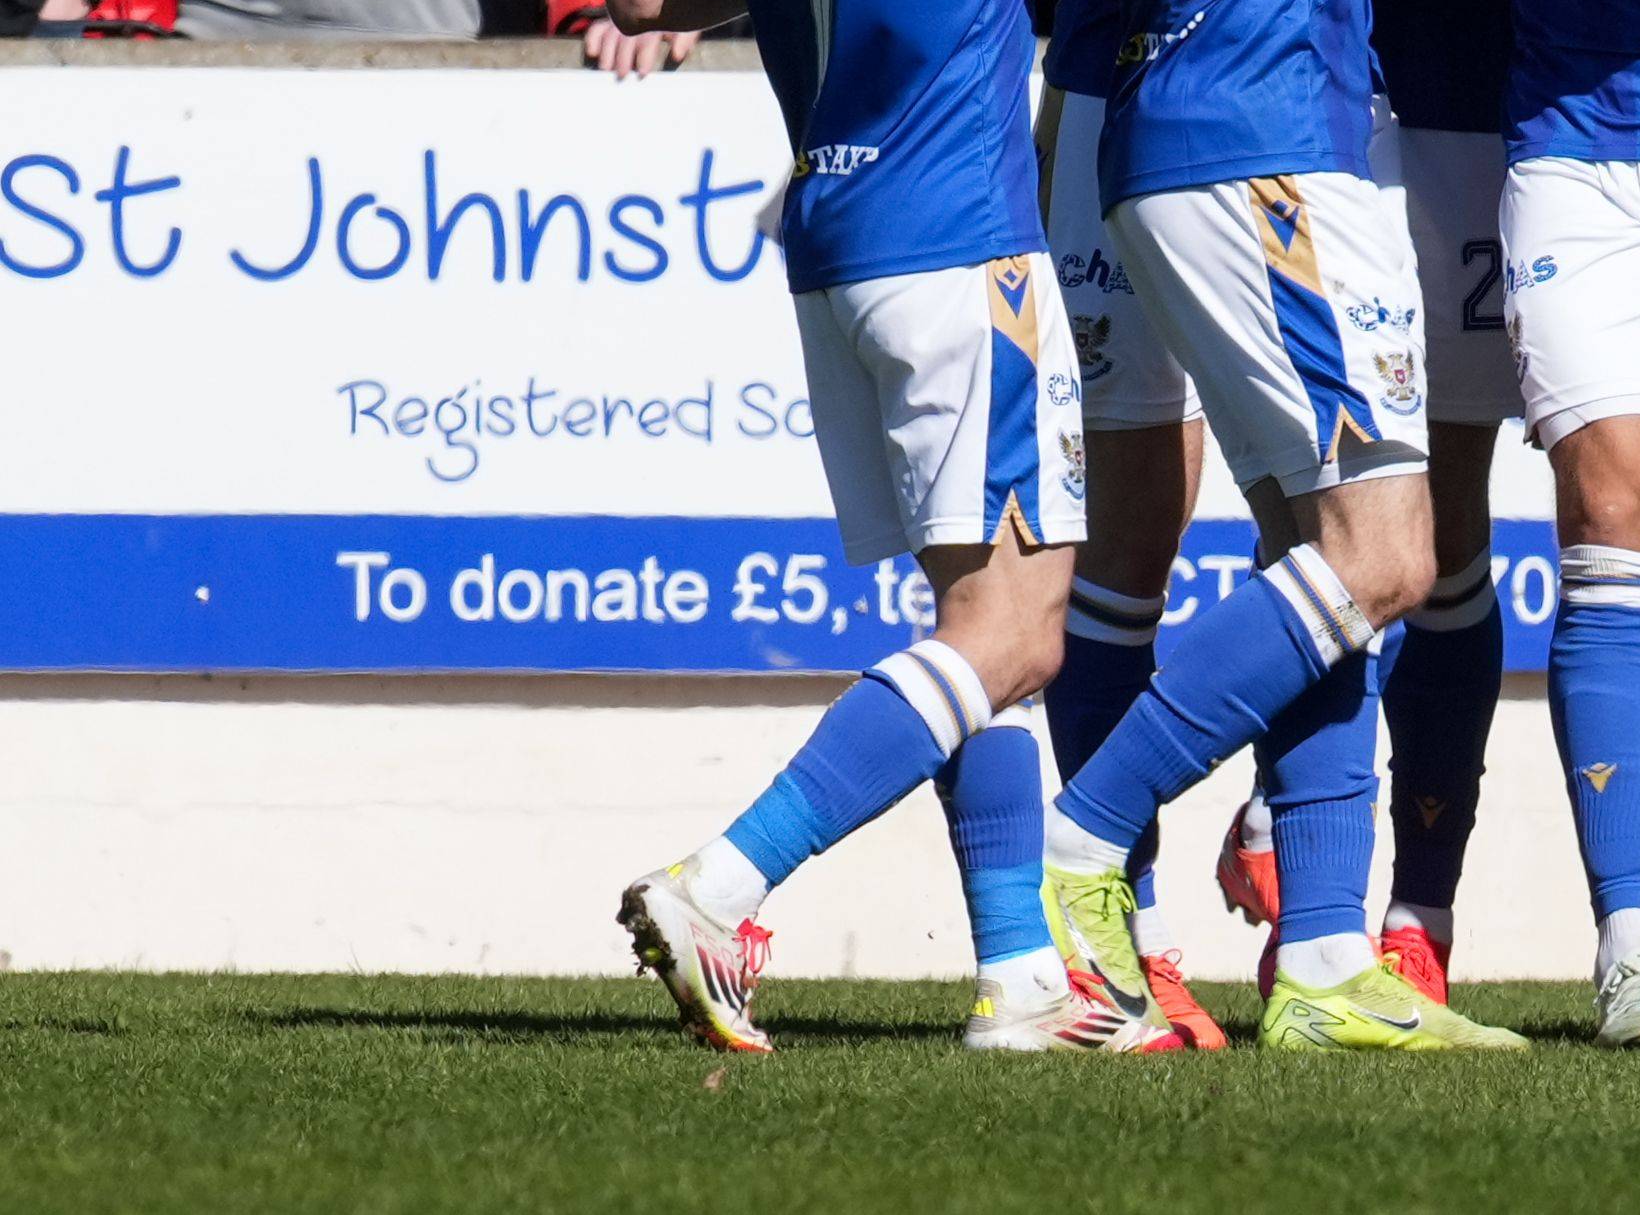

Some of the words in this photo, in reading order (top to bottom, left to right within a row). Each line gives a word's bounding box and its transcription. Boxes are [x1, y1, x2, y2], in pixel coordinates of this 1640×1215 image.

[0, 145, 183, 280] St
[337, 378, 714, 482] Registered
[337, 552, 425, 622] To
[450, 552, 709, 624] donate
[731, 553, 849, 634] £5,
